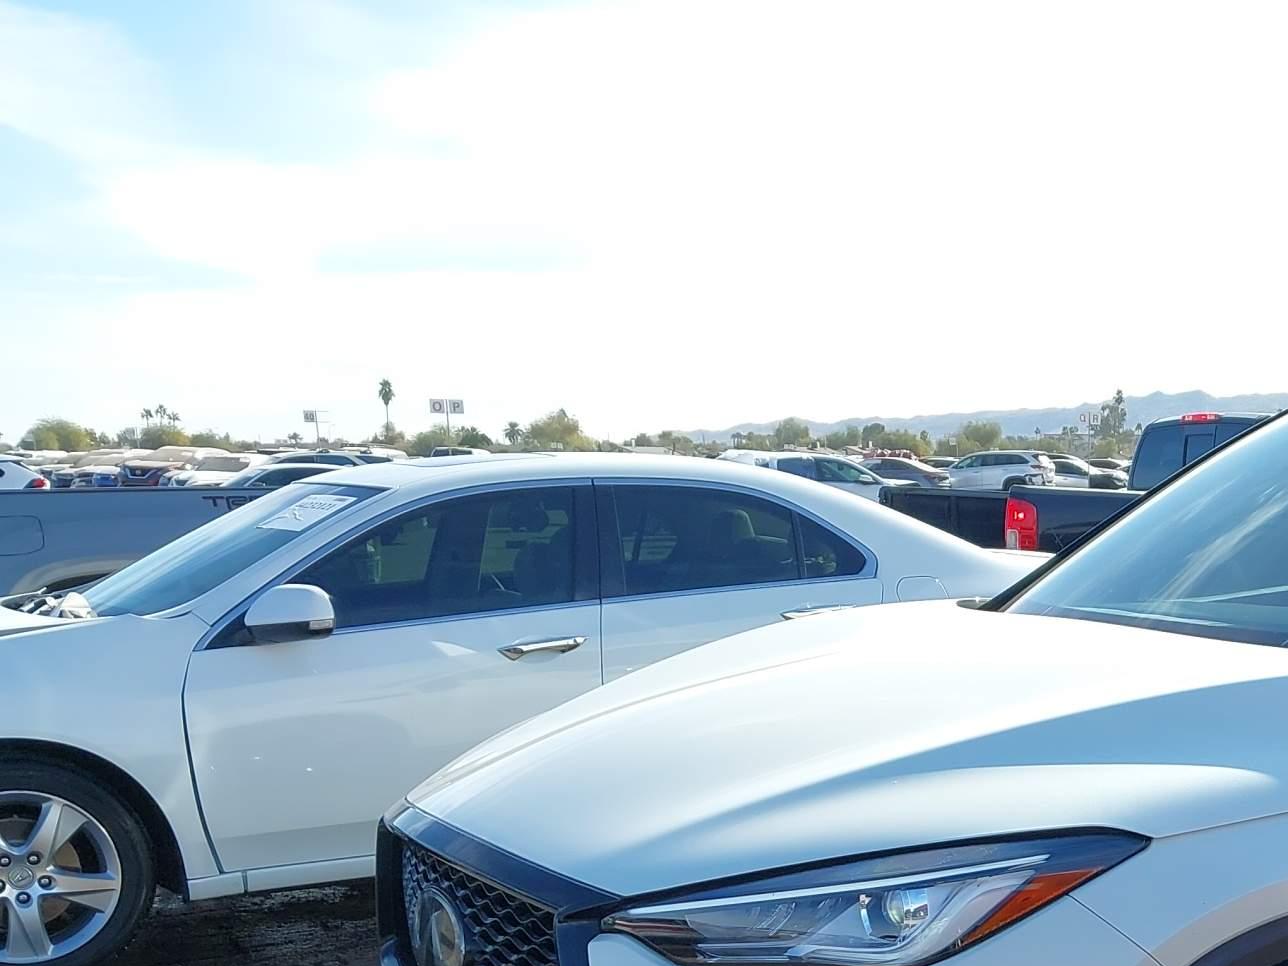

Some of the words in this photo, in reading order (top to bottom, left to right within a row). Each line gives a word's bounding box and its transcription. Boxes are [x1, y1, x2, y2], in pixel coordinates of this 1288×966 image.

[432, 401, 442, 412] O
[452, 401, 460, 412] P
[201, 495, 261, 511] TR
